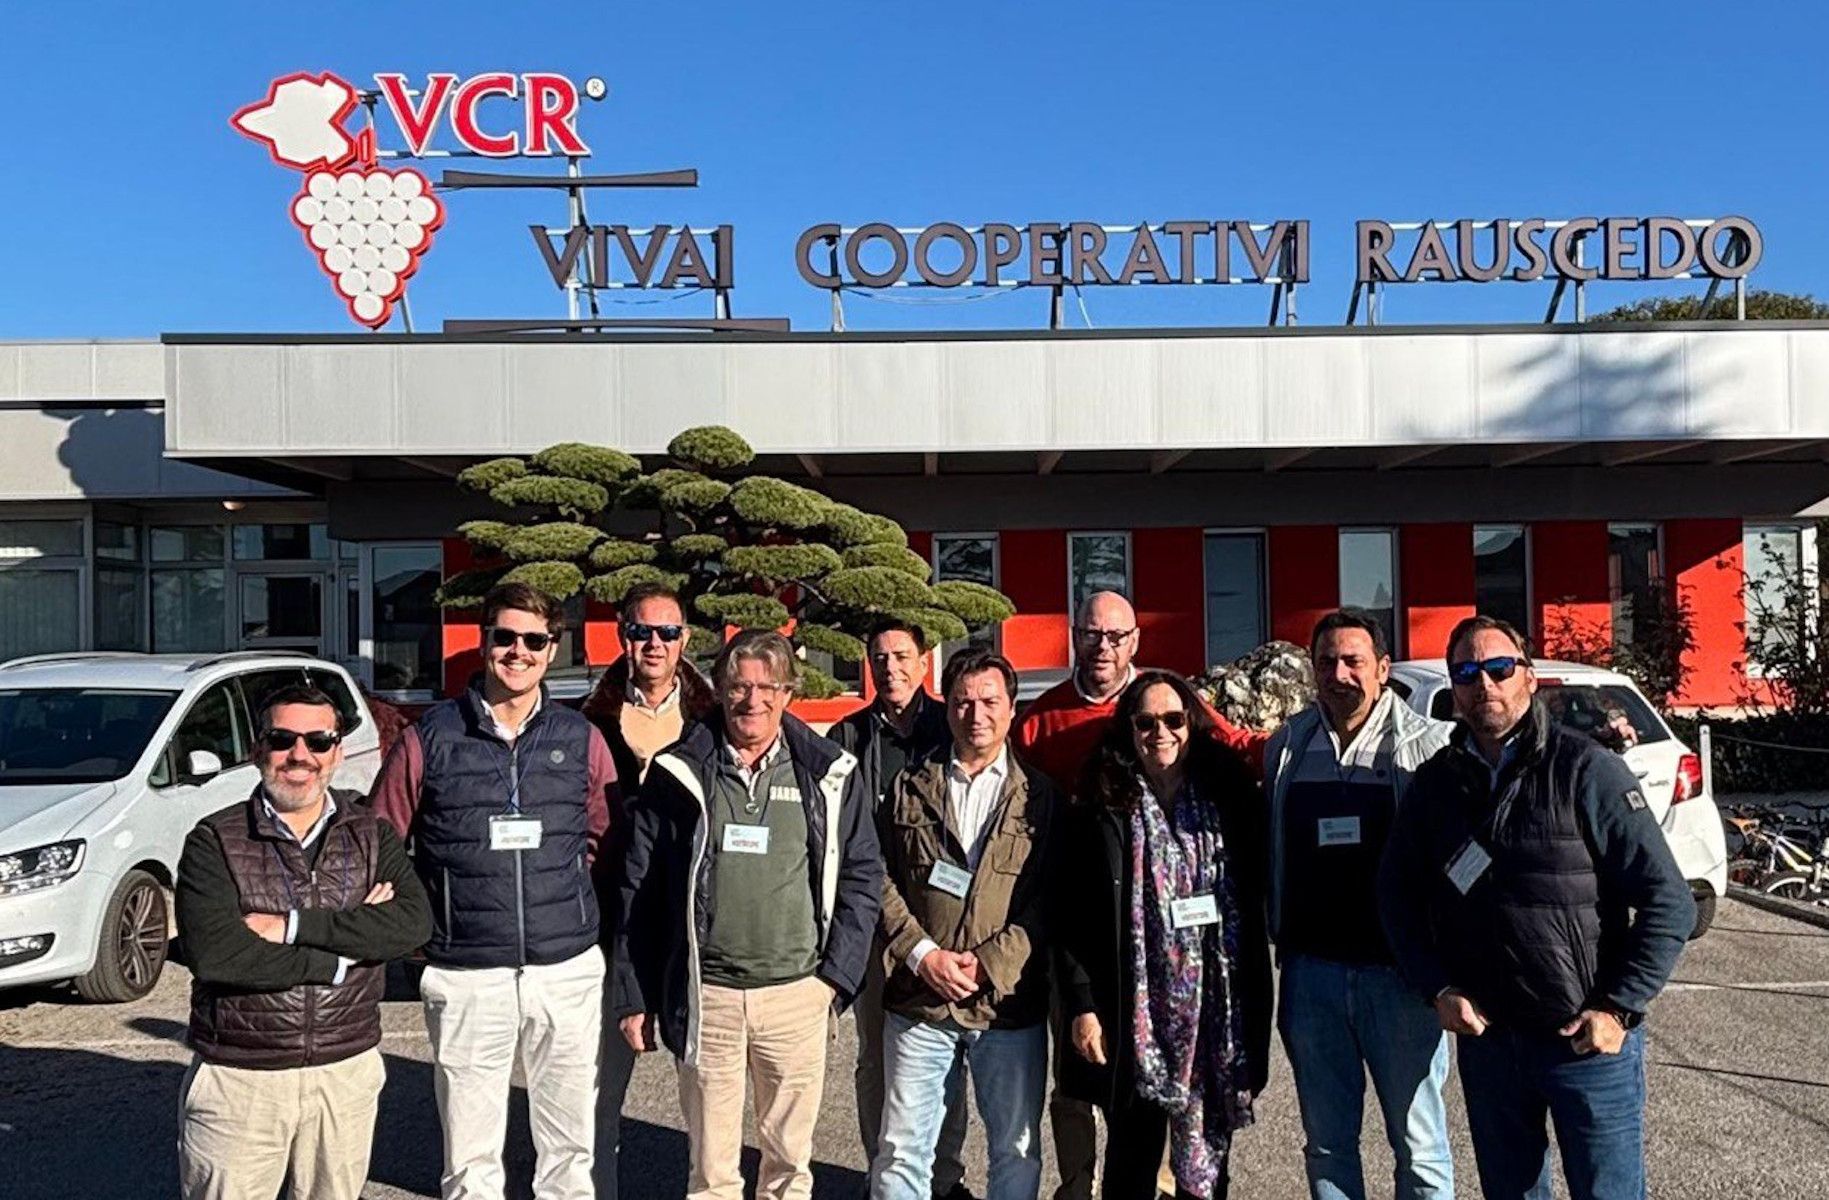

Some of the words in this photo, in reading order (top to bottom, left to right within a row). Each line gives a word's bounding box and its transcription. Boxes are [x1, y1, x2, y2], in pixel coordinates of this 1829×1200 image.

[374, 73, 591, 158] VCR
[529, 224, 734, 289] VIVAI
[795, 219, 1310, 288] COOPERATIVI
[1356, 216, 1763, 282] RAUSCEDO
